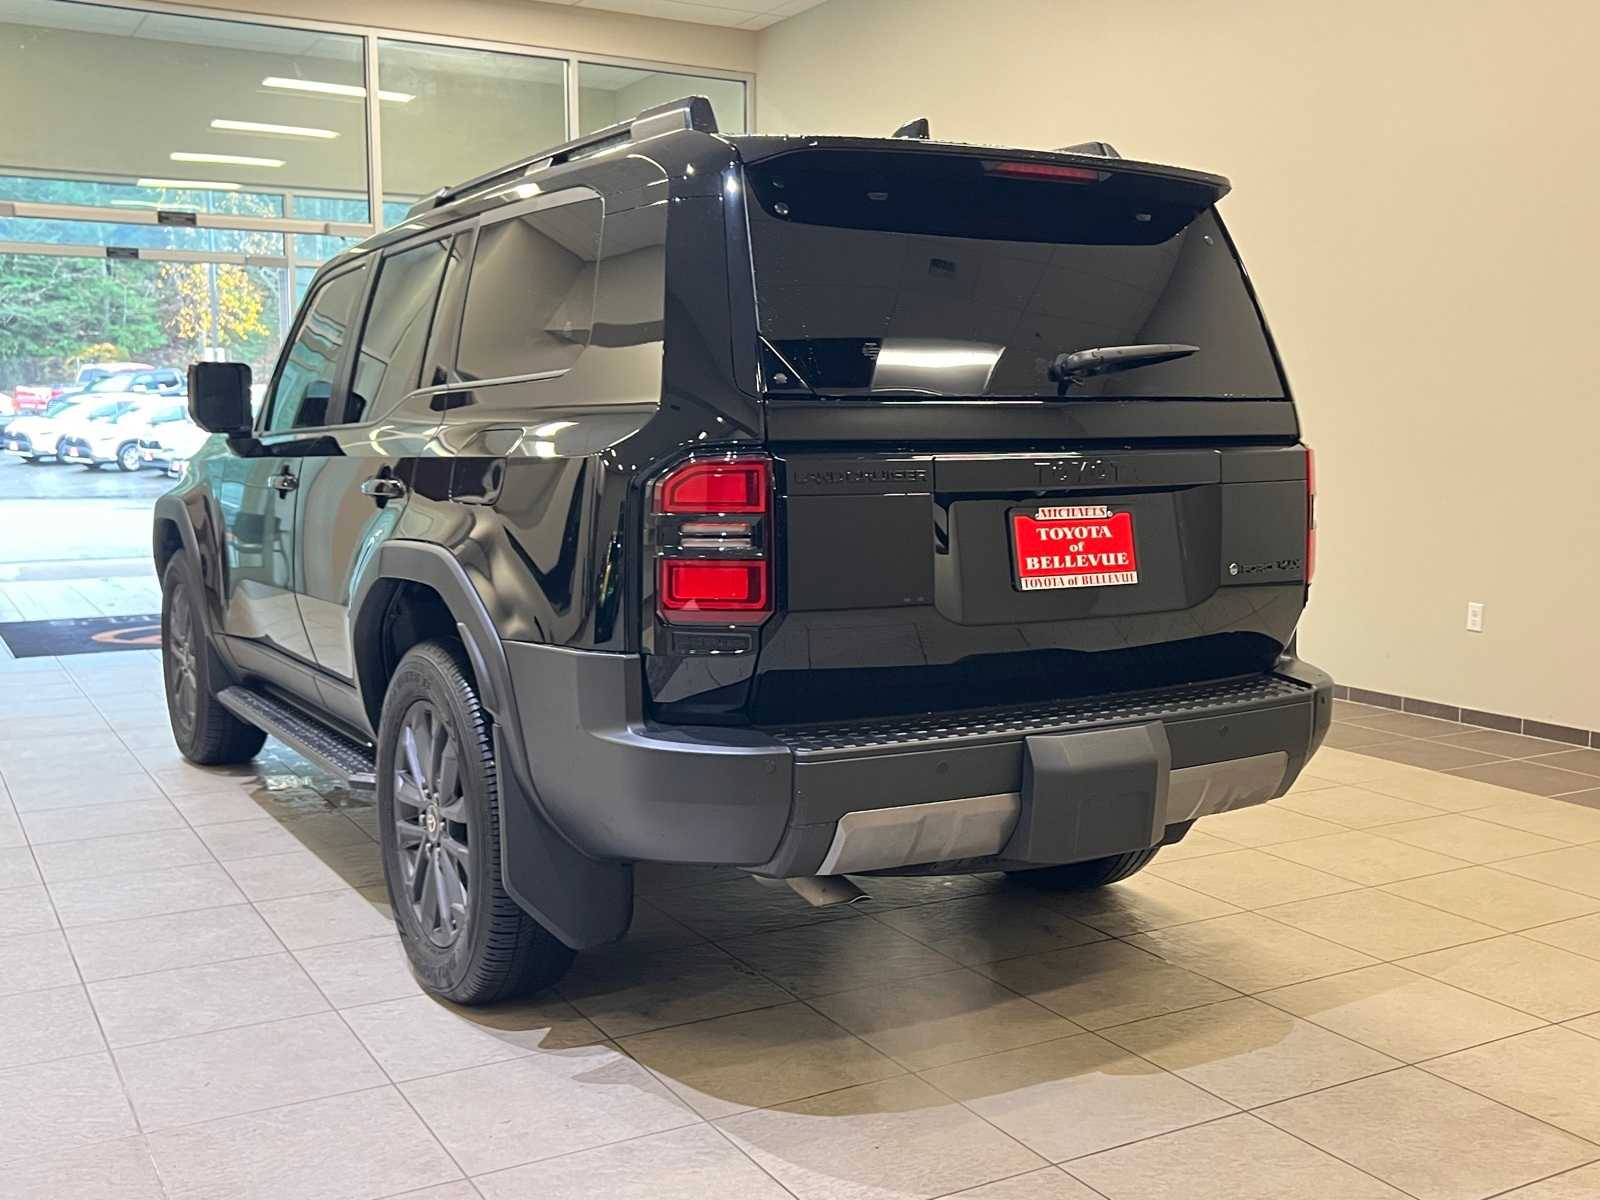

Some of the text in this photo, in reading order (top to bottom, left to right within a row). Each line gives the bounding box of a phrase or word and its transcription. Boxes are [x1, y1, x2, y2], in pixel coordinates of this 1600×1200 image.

[1036, 526, 1112, 541] TOYOTA
[1069, 542, 1084, 552] of
[1025, 553, 1128, 570] BELLEVUE
[1024, 573, 1135, 589] TOYOTA of BELLEVUE
